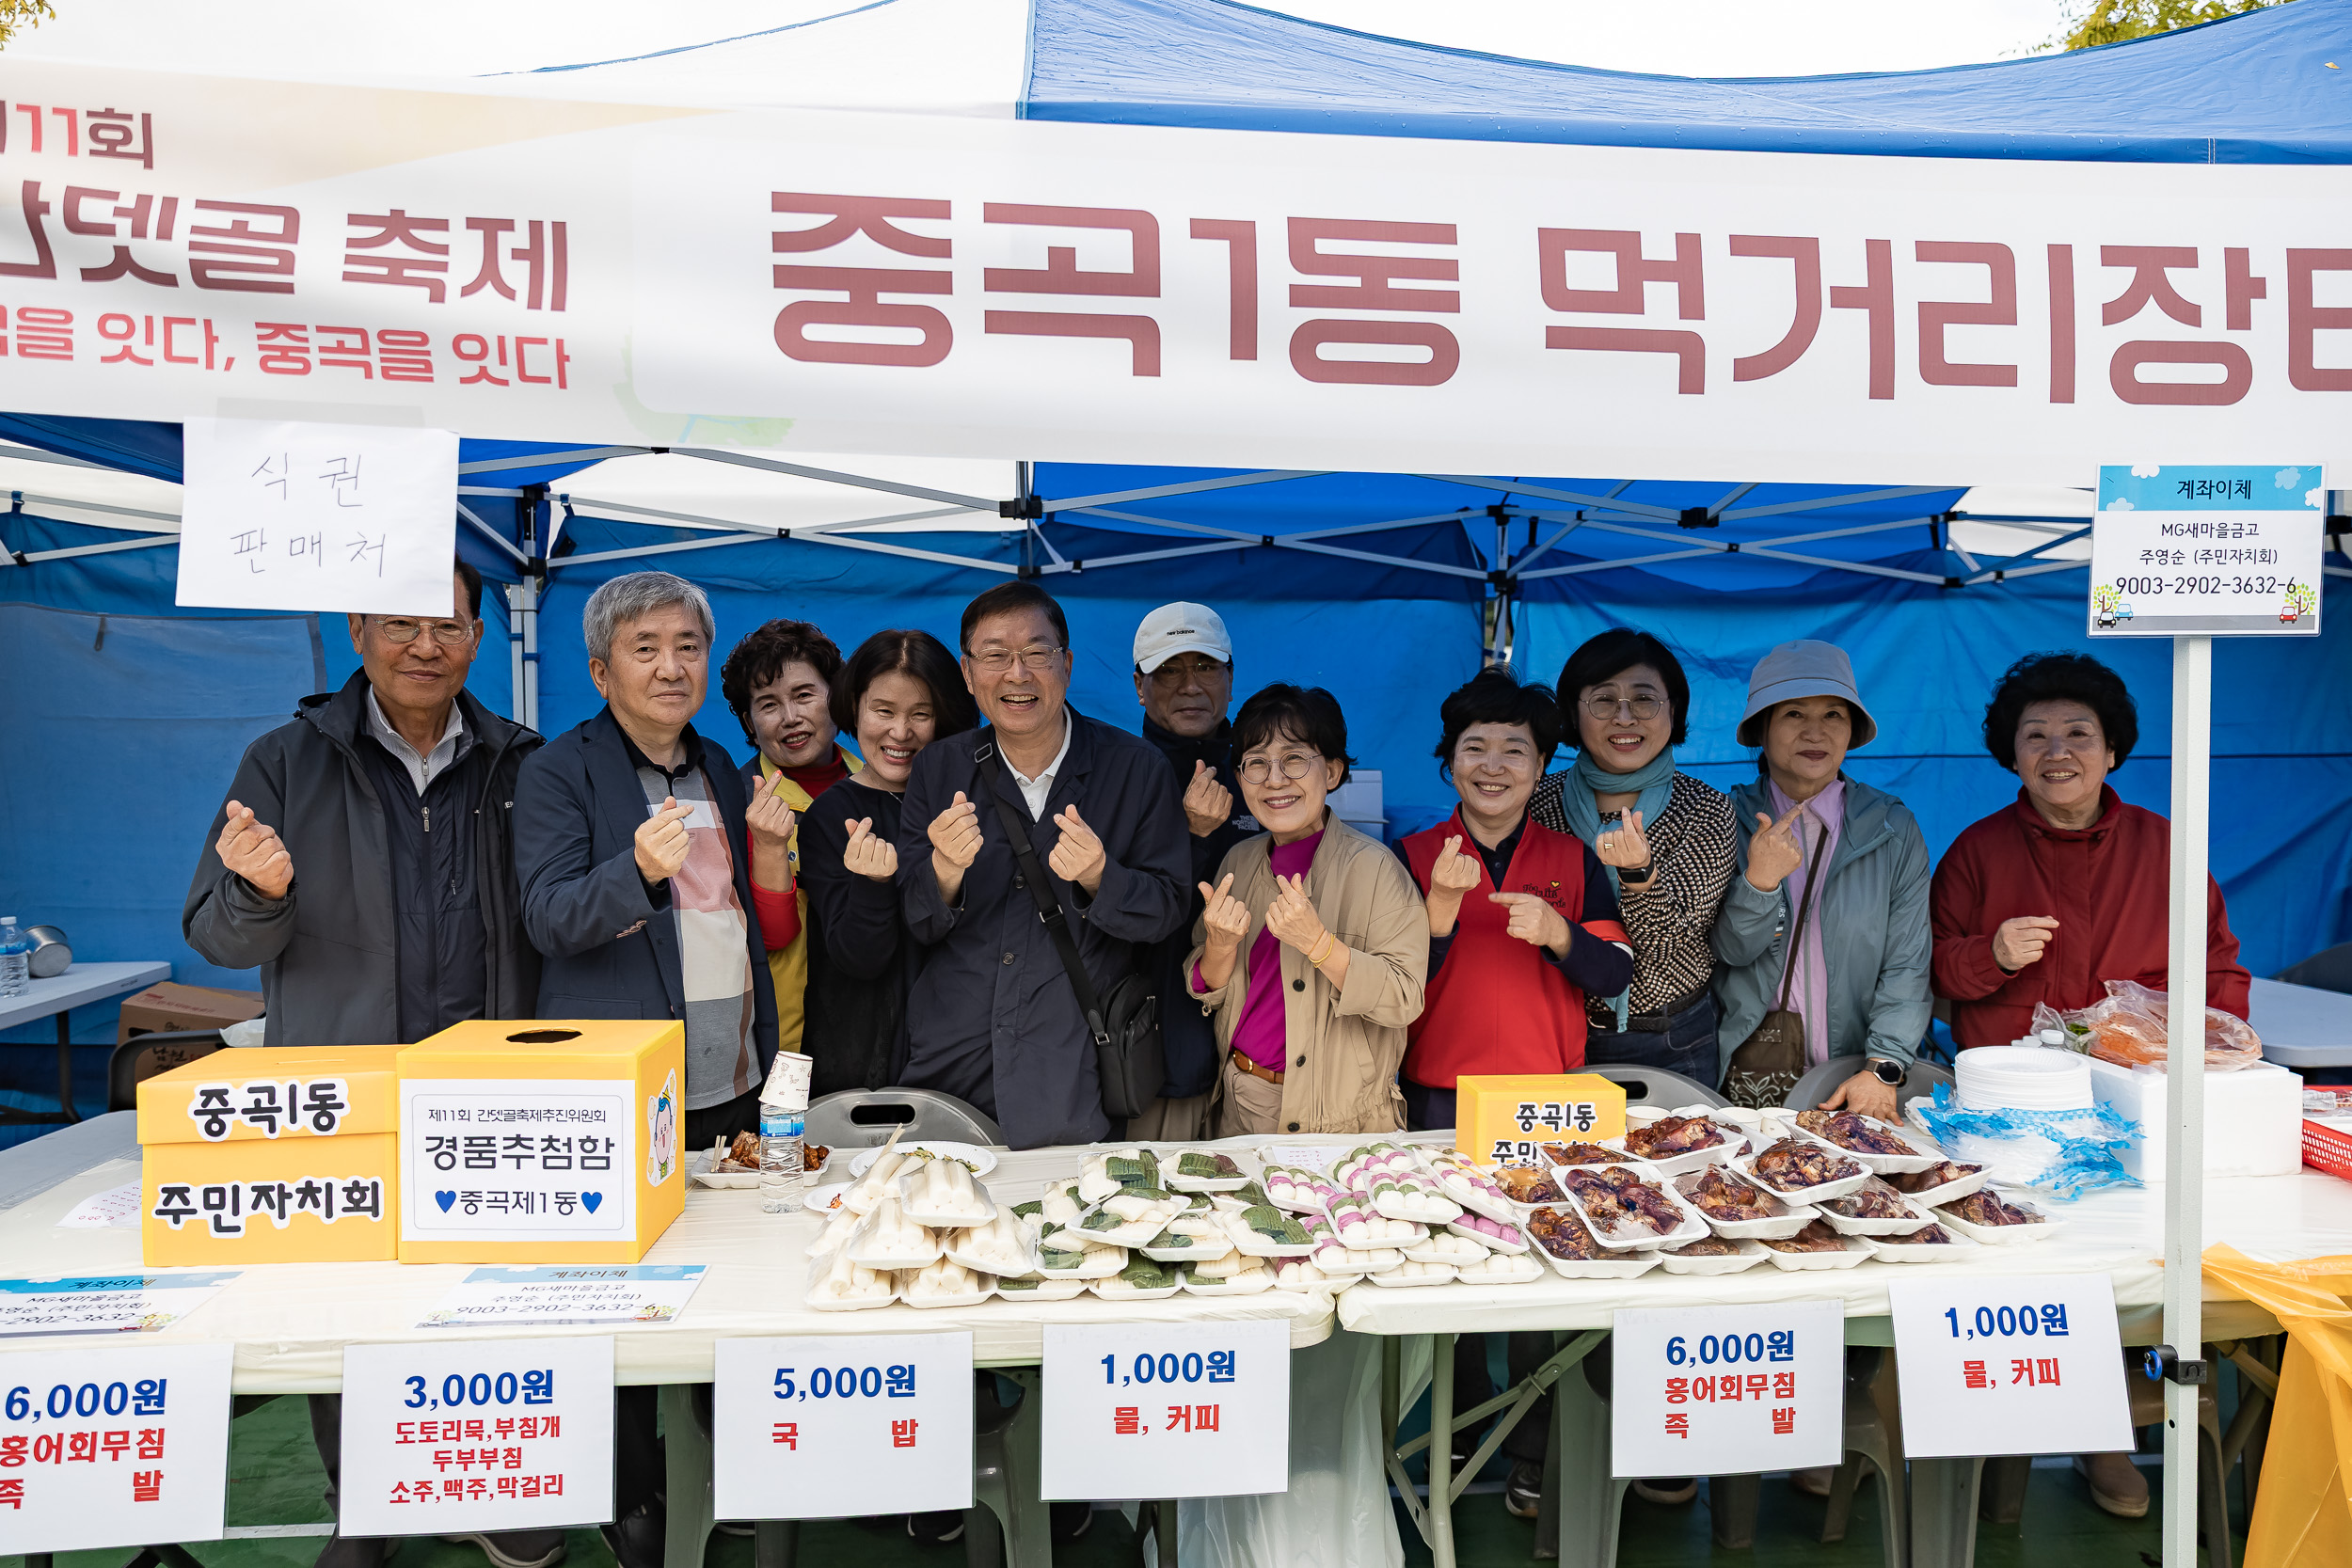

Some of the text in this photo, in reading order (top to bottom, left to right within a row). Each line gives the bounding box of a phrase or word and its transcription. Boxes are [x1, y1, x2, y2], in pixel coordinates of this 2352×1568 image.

[0, 100, 153, 170] 11회
[342, 209, 567, 312] 축제
[771, 191, 1460, 387] 중곡1동
[0, 304, 570, 390] 을 잇다, 중곡을 잇다
[2176, 479, 2252, 500] 계좌이체
[2161, 522, 2260, 539] MG새마을금고
[2139, 548, 2279, 566] 주영순 (주민자치회)
[2115, 576, 2296, 595] 9003-2902-3632-6
[428, 1108, 470, 1122] 제11회
[425, 1133, 615, 1171] 경품추첨함
[154, 1180, 384, 1233] 주민자치회
[460, 1190, 578, 1215] 중곡제1동
[68, 1278, 158, 1290] 계좌이체
[521, 1284, 626, 1292] MG새마을금고
[548, 1269, 628, 1279] 계좌이체
[26, 1293, 142, 1304] MG새마을금고
[48, 1302, 152, 1313] (주민자치회)
[457, 1304, 657, 1315] 9003-2902-3632-6
[490, 1293, 642, 1303] 주영순 (주민자치회)
[1944, 1302, 2071, 1341] 1,000원
[1665, 1330, 1795, 1368] 6,000원
[773, 1364, 917, 1402] 5,000원
[1101, 1350, 1236, 1389] 1,000원
[1963, 1357, 2061, 1390] 물, 커피
[5, 1378, 167, 1423] 6,000원
[404, 1369, 555, 1412] 3,000원
[1664, 1371, 1796, 1405] 홍어회무침
[394, 1416, 562, 1445] 도토리묵,부침개
[1113, 1403, 1221, 1436] 물, 커피
[0, 1428, 166, 1467] 홍어회무침
[431, 1447, 523, 1473] 두부부침
[389, 1473, 564, 1506] 소주,맥주,막걸리
